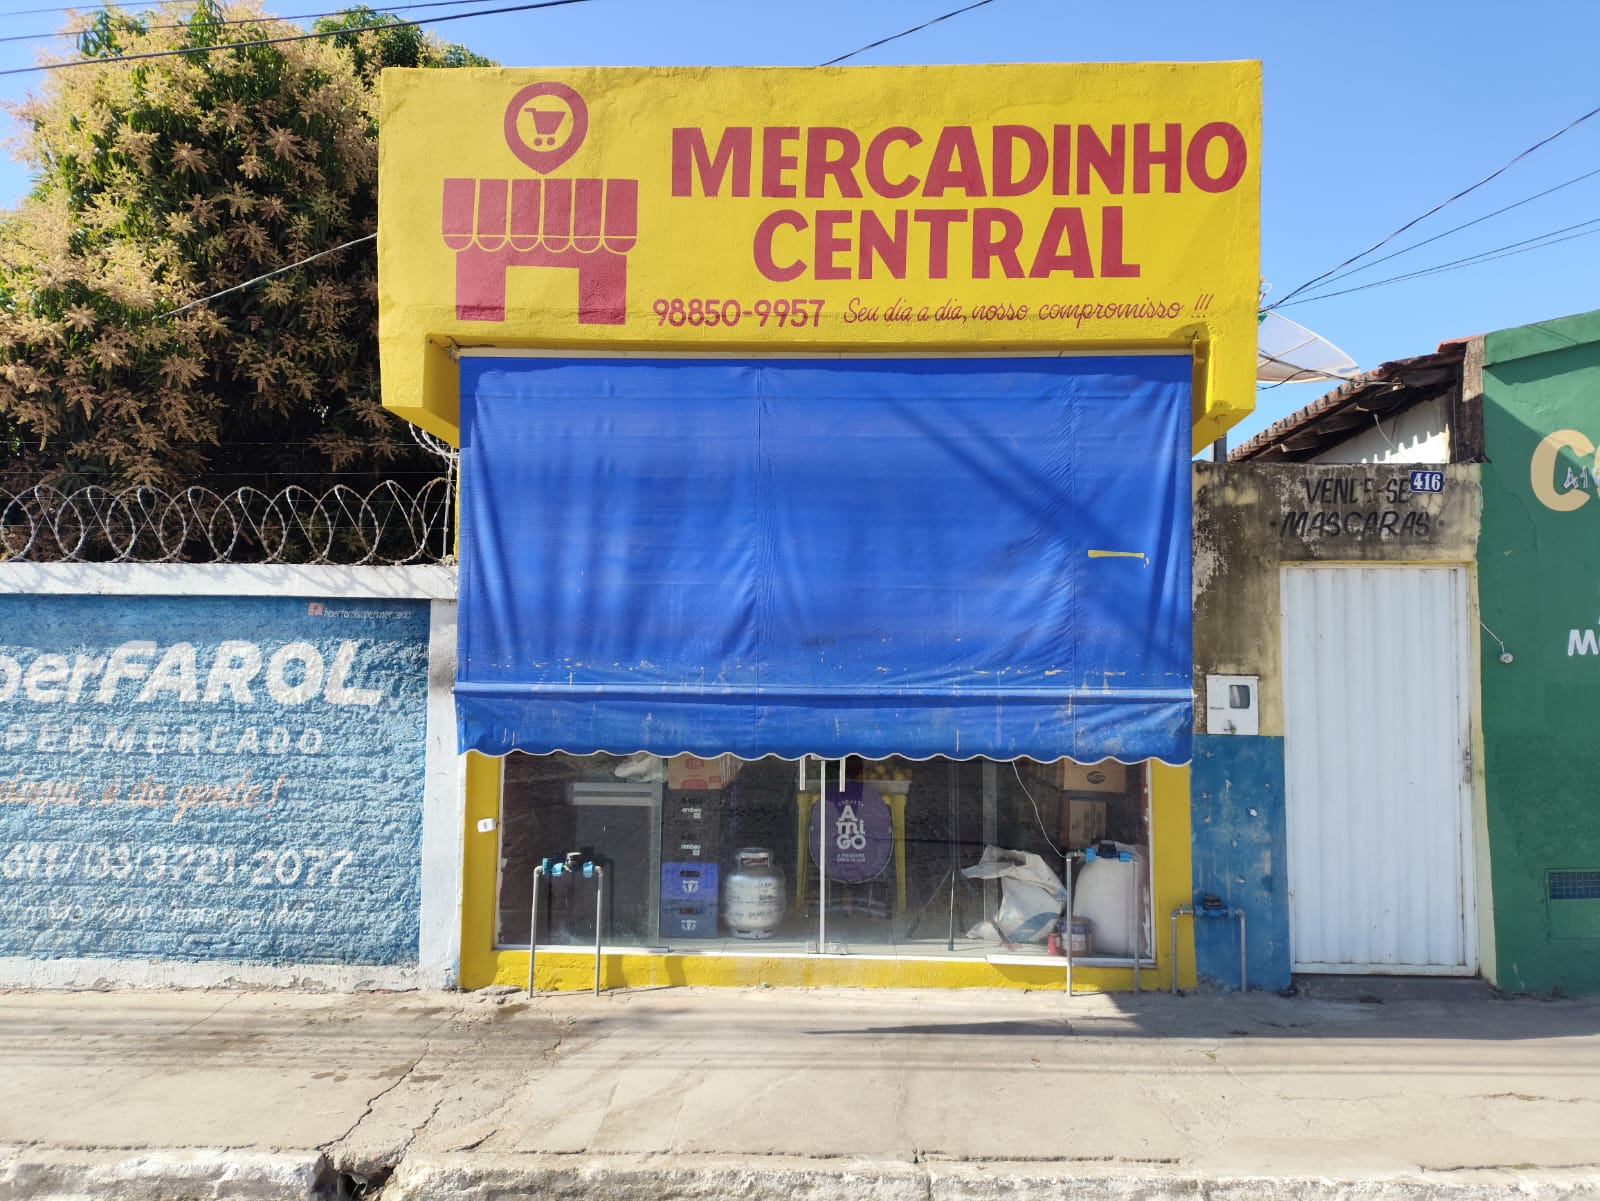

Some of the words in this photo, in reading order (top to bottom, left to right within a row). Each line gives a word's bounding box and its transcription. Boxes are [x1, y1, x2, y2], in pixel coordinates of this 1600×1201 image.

[671, 121, 1247, 199] MERCADINHO
[753, 205, 1141, 282] CENTRAL
[653, 298, 826, 328] 98850-9957
[843, 297, 880, 323] Seu
[882, 297, 912, 323] dia
[916, 305, 930, 322] a
[934, 298, 967, 324] dia,
[971, 302, 1029, 321] nosso
[1038, 297, 1184, 329] compromisso
[1413, 473, 1441, 491] 416
[1530, 429, 1600, 512] C
[1279, 511, 1431, 538] MASCARAS
[1567, 629, 1600, 657] M
